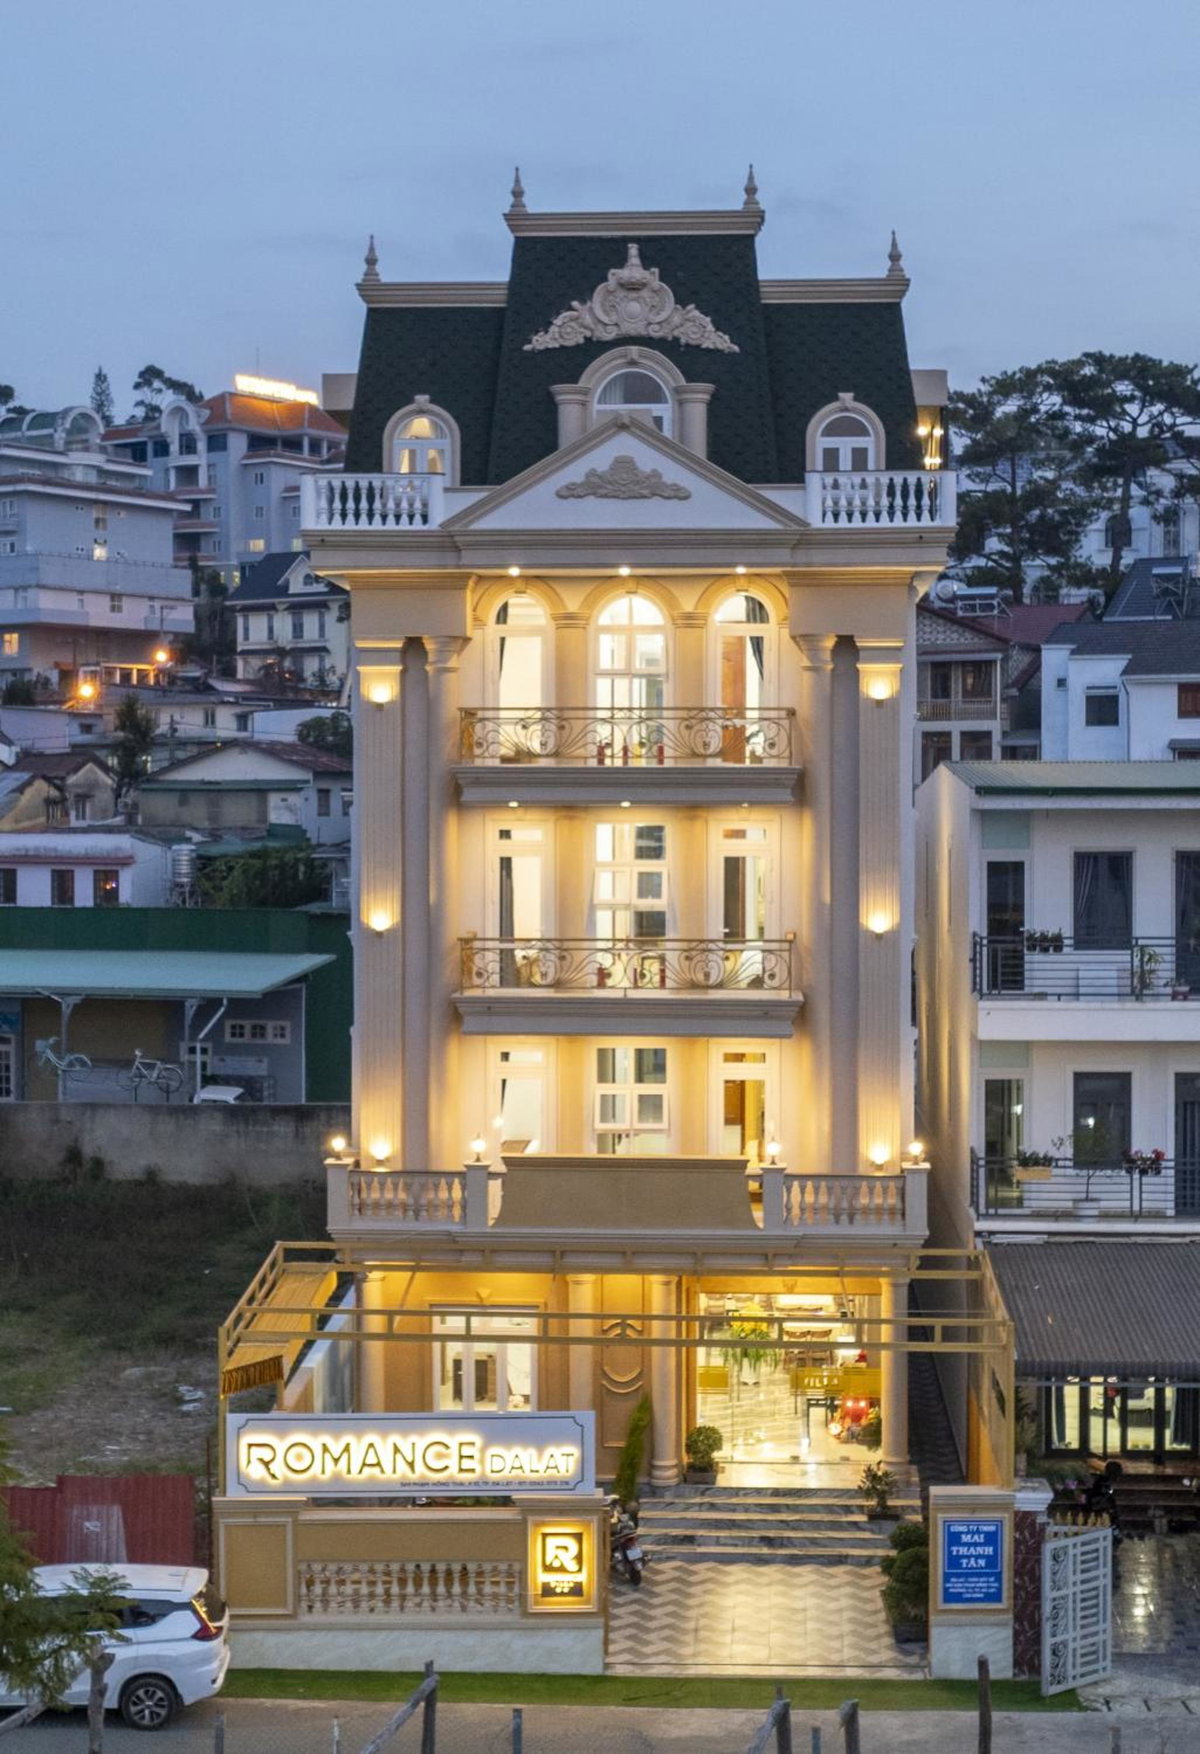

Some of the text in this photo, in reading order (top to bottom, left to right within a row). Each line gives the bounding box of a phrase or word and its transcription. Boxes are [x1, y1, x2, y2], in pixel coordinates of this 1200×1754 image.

[245, 1440, 575, 1481] ROMANCE DALAT
[960, 1533, 985, 1543] MAI
[951, 1546, 994, 1555] THANH
[960, 1557, 986, 1568] TÂN
